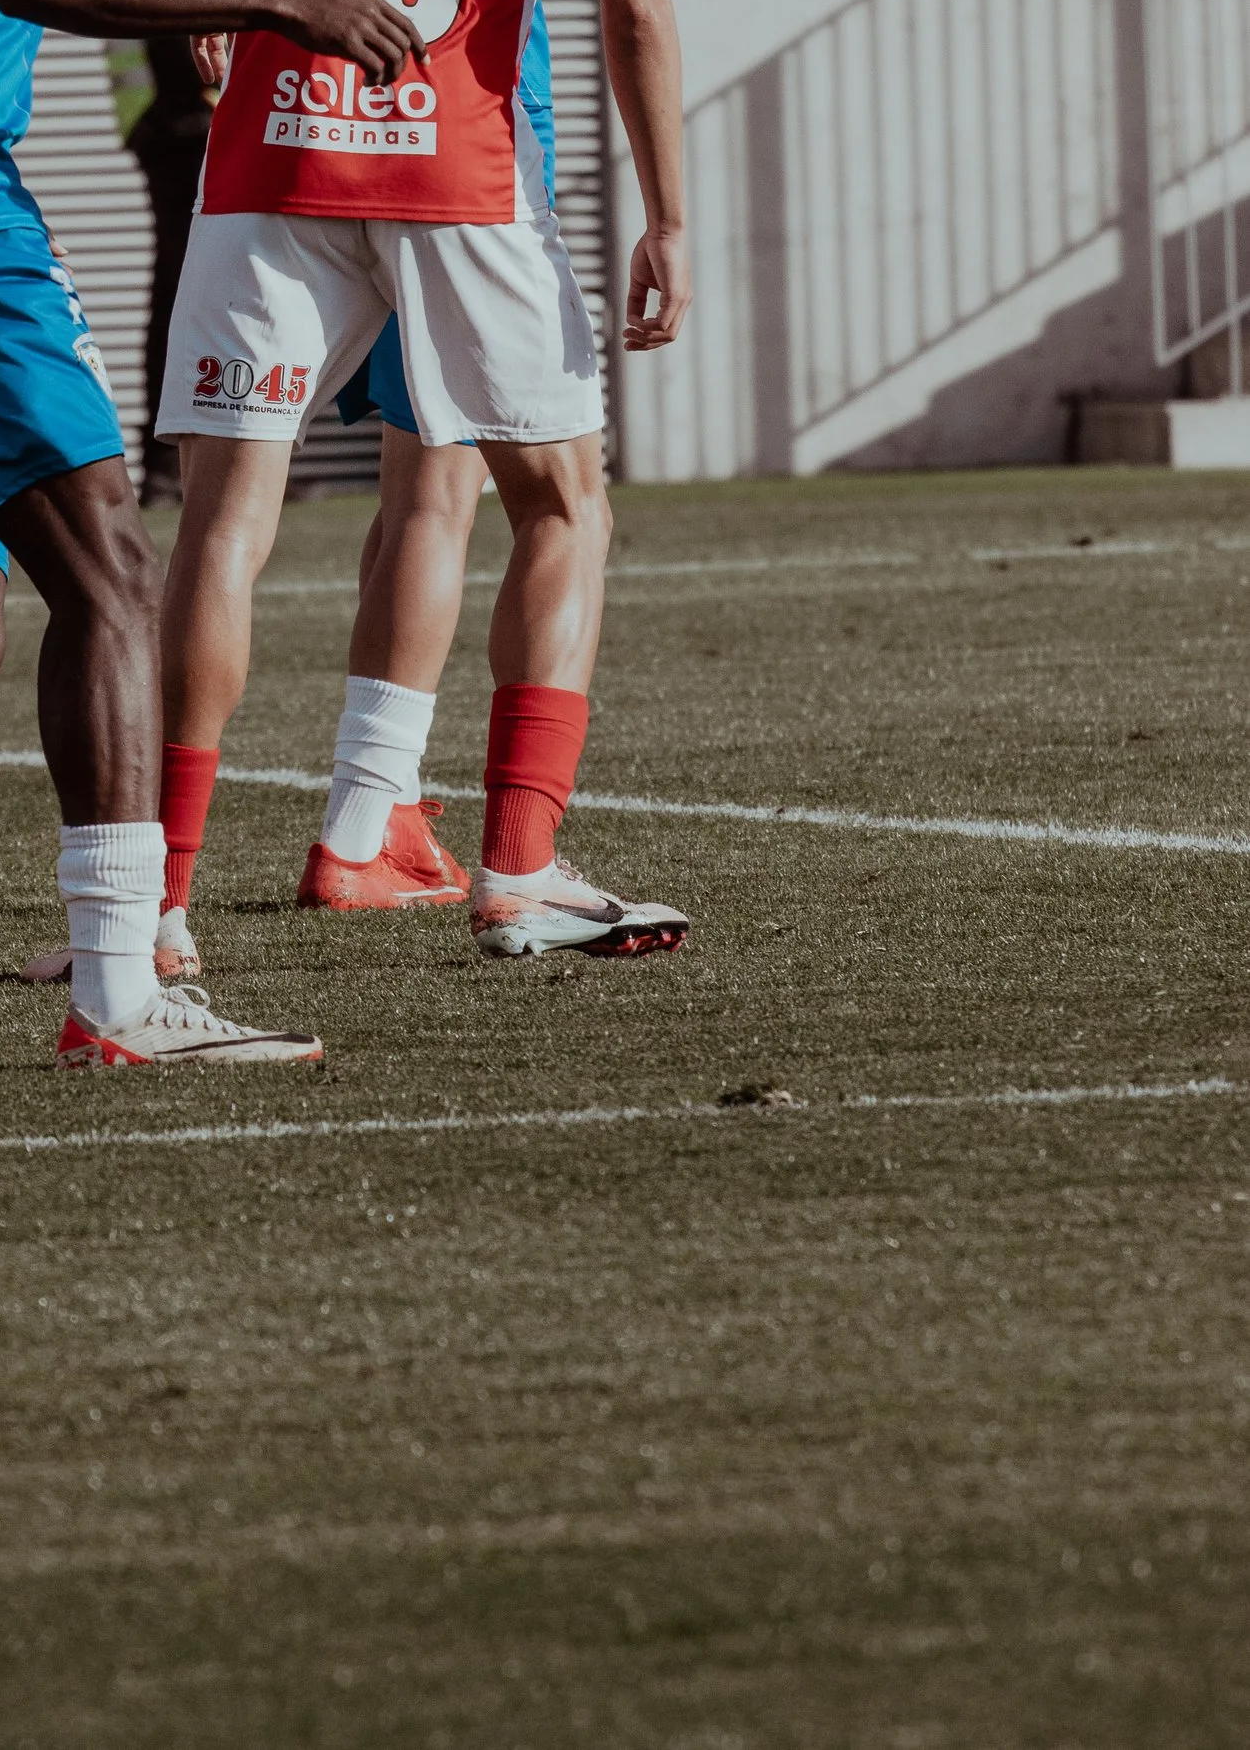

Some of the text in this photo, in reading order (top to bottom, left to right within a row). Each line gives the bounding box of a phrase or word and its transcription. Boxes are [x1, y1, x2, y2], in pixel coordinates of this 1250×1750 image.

[272, 63, 437, 119] soleo
[275, 117, 421, 146] piscinas
[193, 355, 312, 407] 2045
[192, 399, 228, 410] EMPRESA
[229, 403, 242, 411] DE
